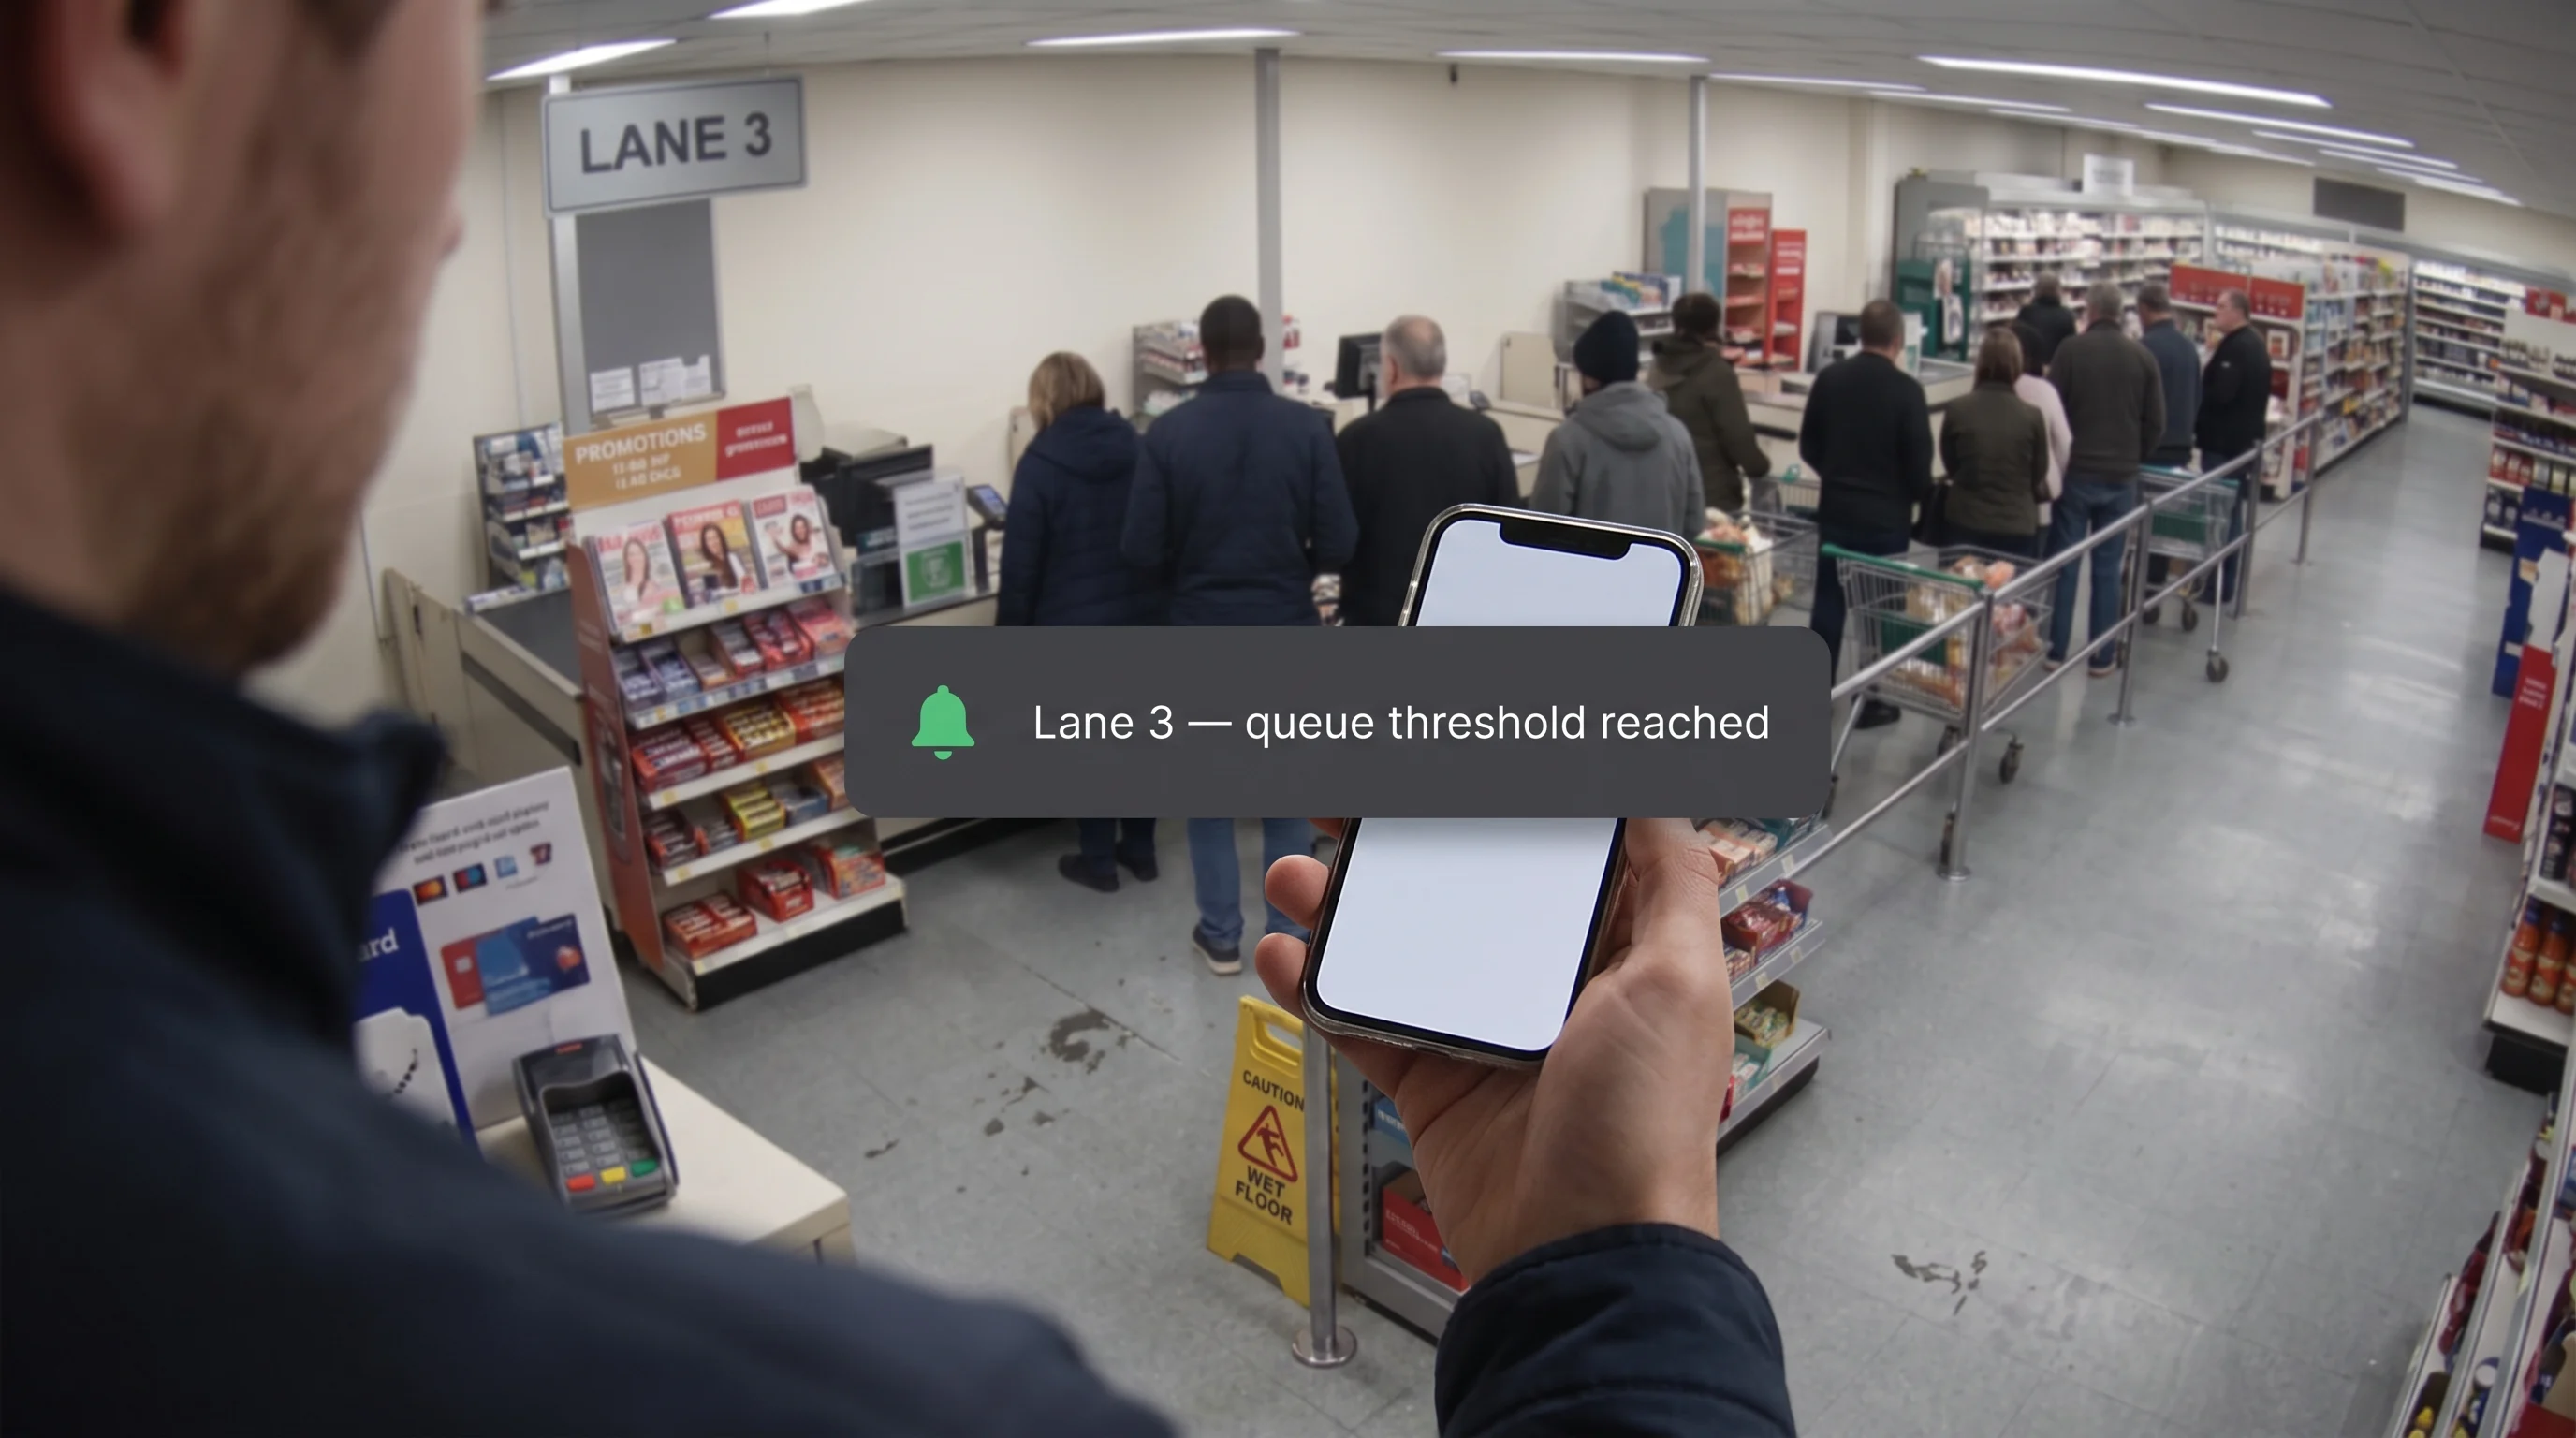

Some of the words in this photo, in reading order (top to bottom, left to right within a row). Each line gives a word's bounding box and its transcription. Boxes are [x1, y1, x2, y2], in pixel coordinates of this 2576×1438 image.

[580, 114, 728, 174] LANE
[744, 110, 773, 157] 3
[574, 423, 707, 465] PROMOTIONS
[1242, 1069, 1305, 1113] CAUTION
[1235, 1180, 1294, 1226] FLOOR
[1247, 1165, 1286, 1198] WET
